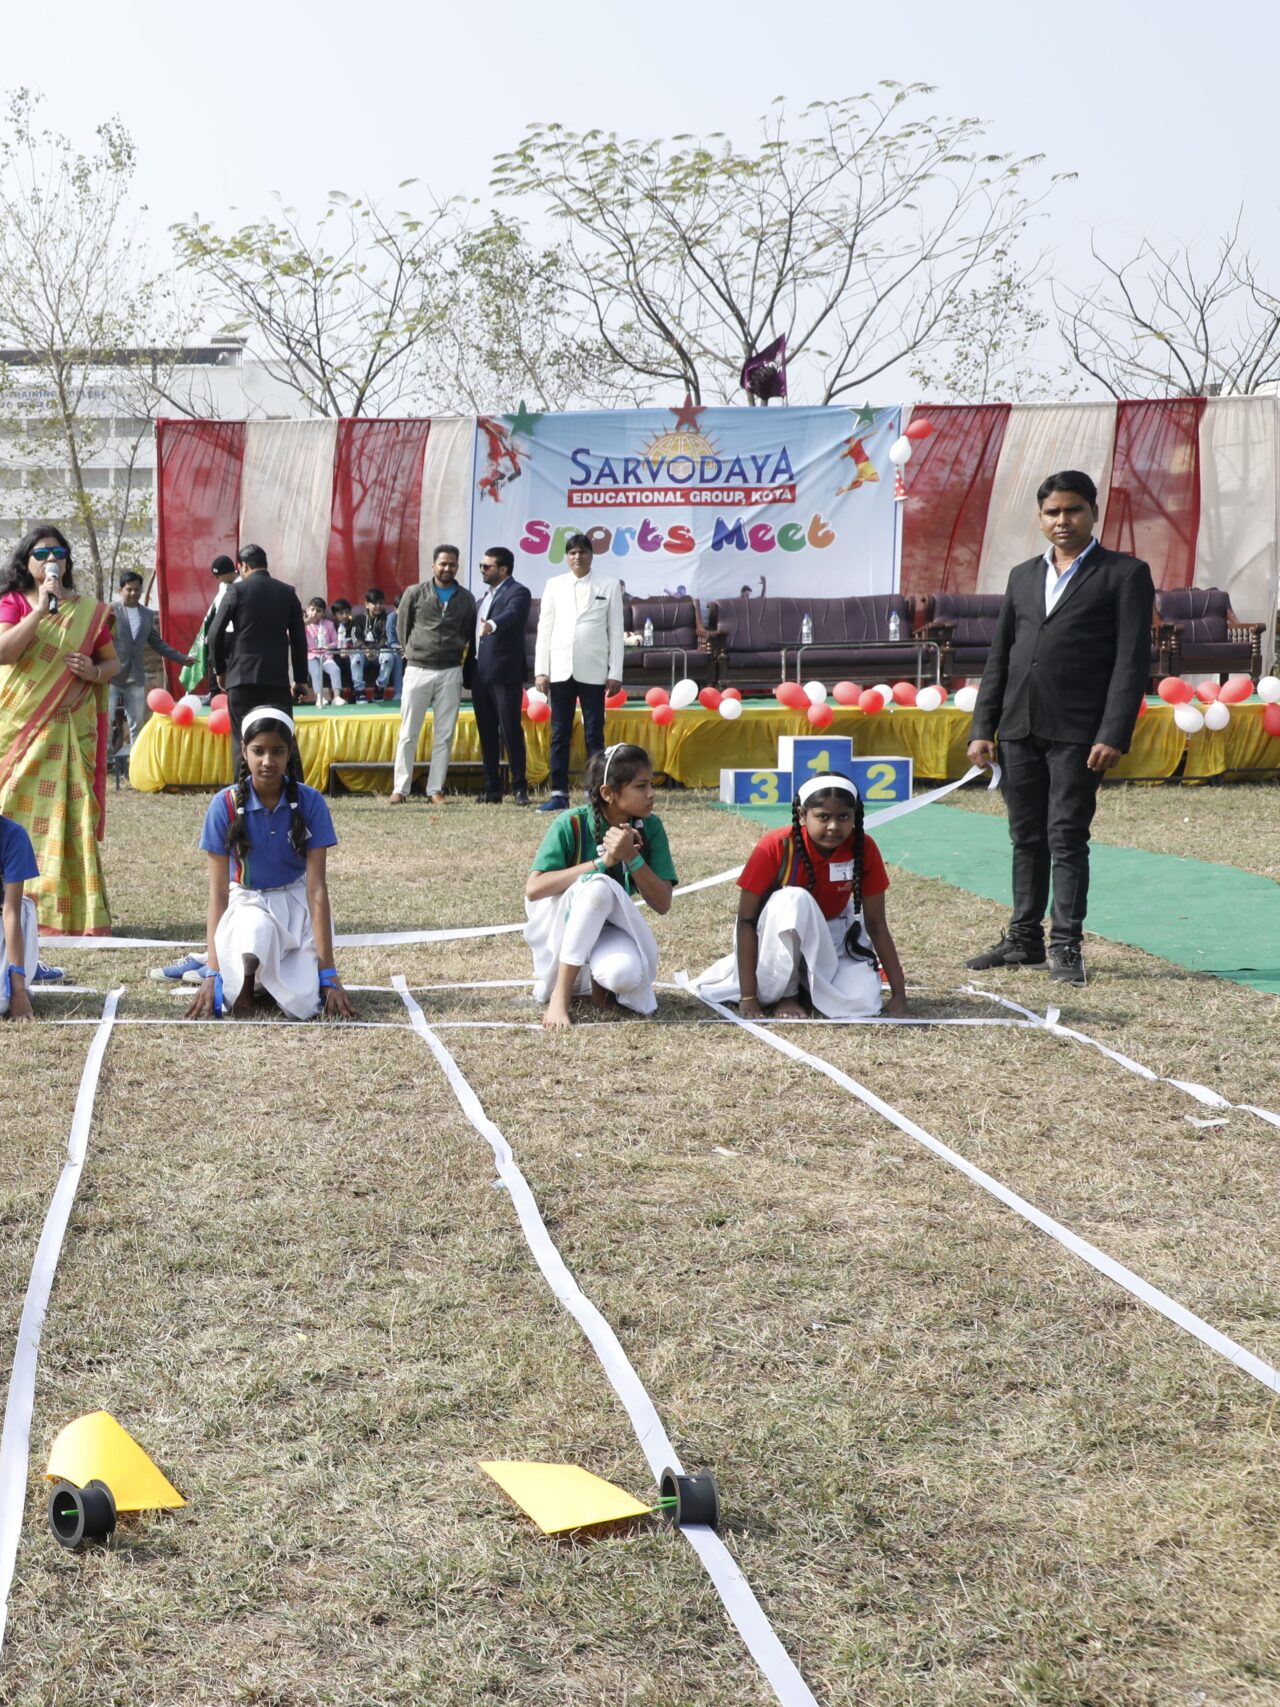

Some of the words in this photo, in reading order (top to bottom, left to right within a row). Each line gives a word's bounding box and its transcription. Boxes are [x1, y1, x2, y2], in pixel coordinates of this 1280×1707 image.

[570, 445, 794, 486] SARVODAYA
[572, 490, 685, 505] EDUCATIONAL
[689, 490, 746, 505] GROUP,
[751, 488, 793, 503] KOTA
[520, 518, 695, 564] Sports
[711, 514, 835, 553] Meet
[750, 772, 779, 803] 3
[866, 764, 897, 799] 2
